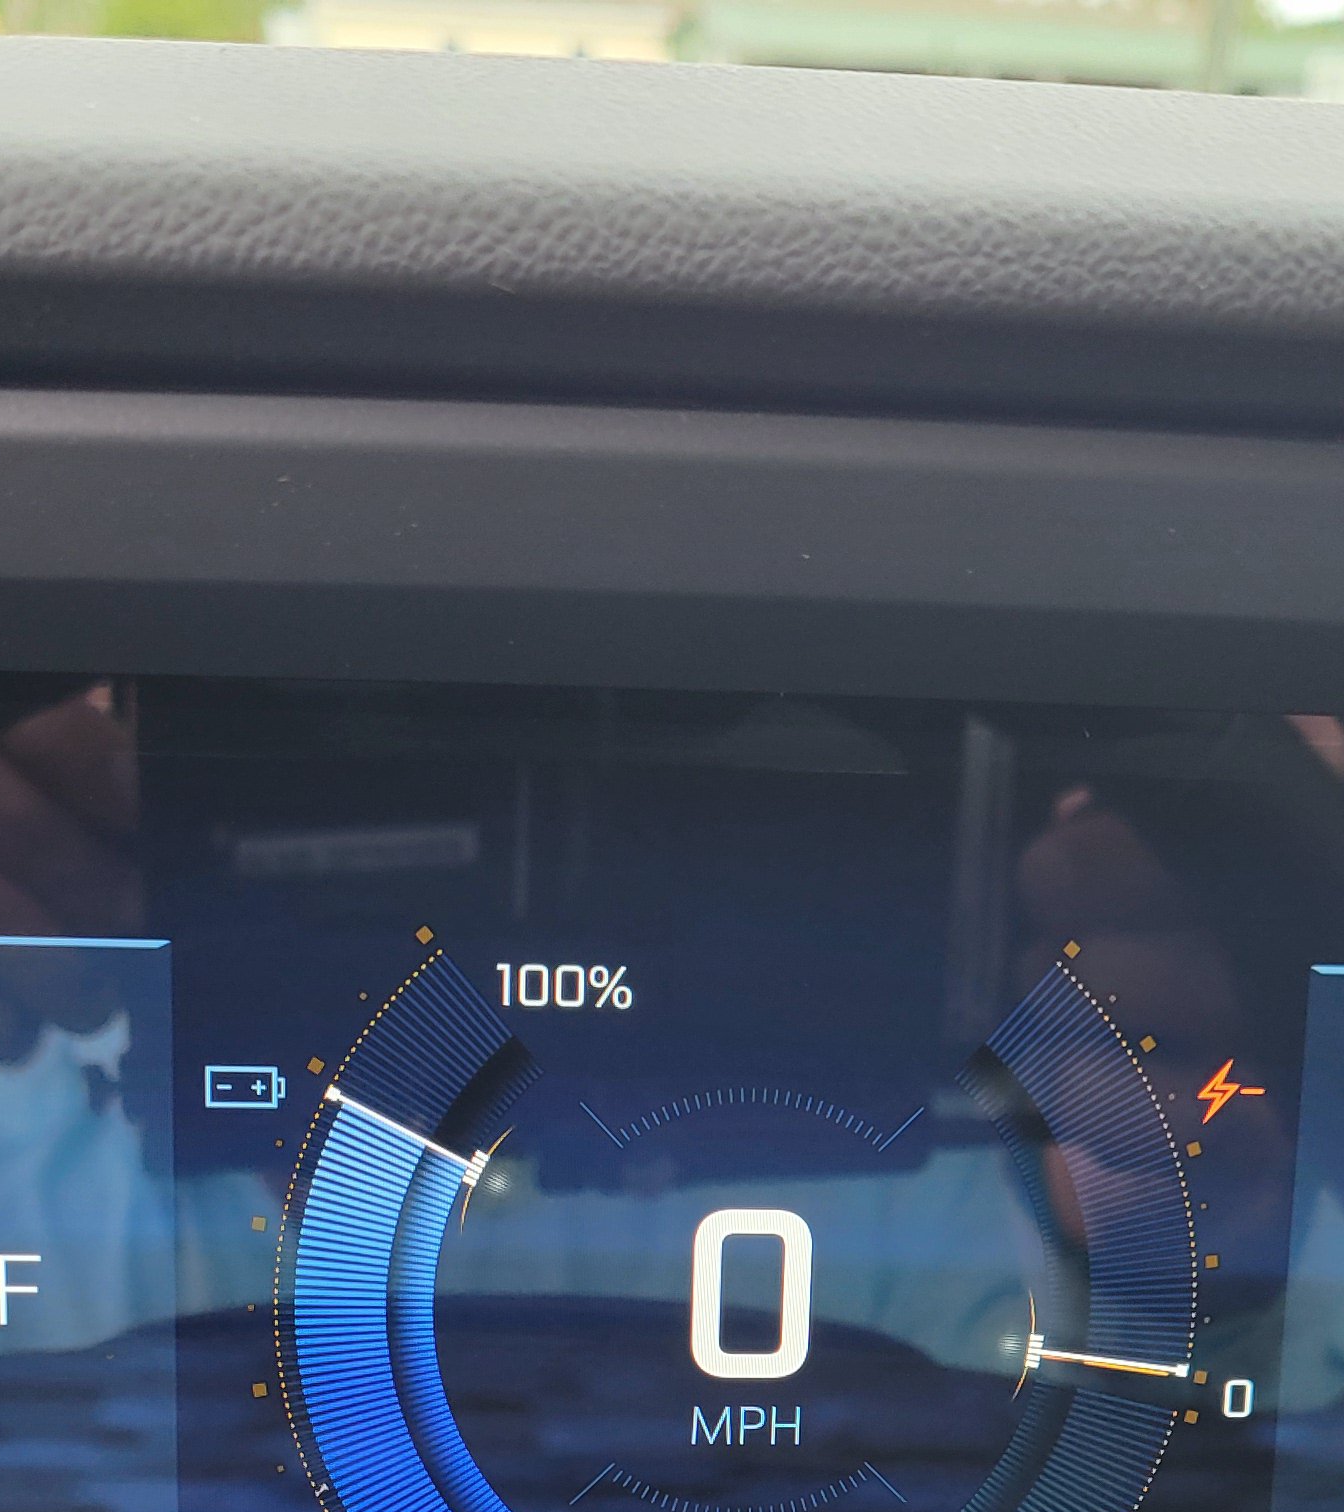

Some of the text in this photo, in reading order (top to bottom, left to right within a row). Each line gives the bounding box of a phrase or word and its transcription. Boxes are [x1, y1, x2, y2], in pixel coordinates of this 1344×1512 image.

[496, 963, 633, 1010] 100%
[691, 1208, 813, 1379] 0
[1223, 1379, 1254, 1418] 0
[691, 1405, 801, 1445] MPH
